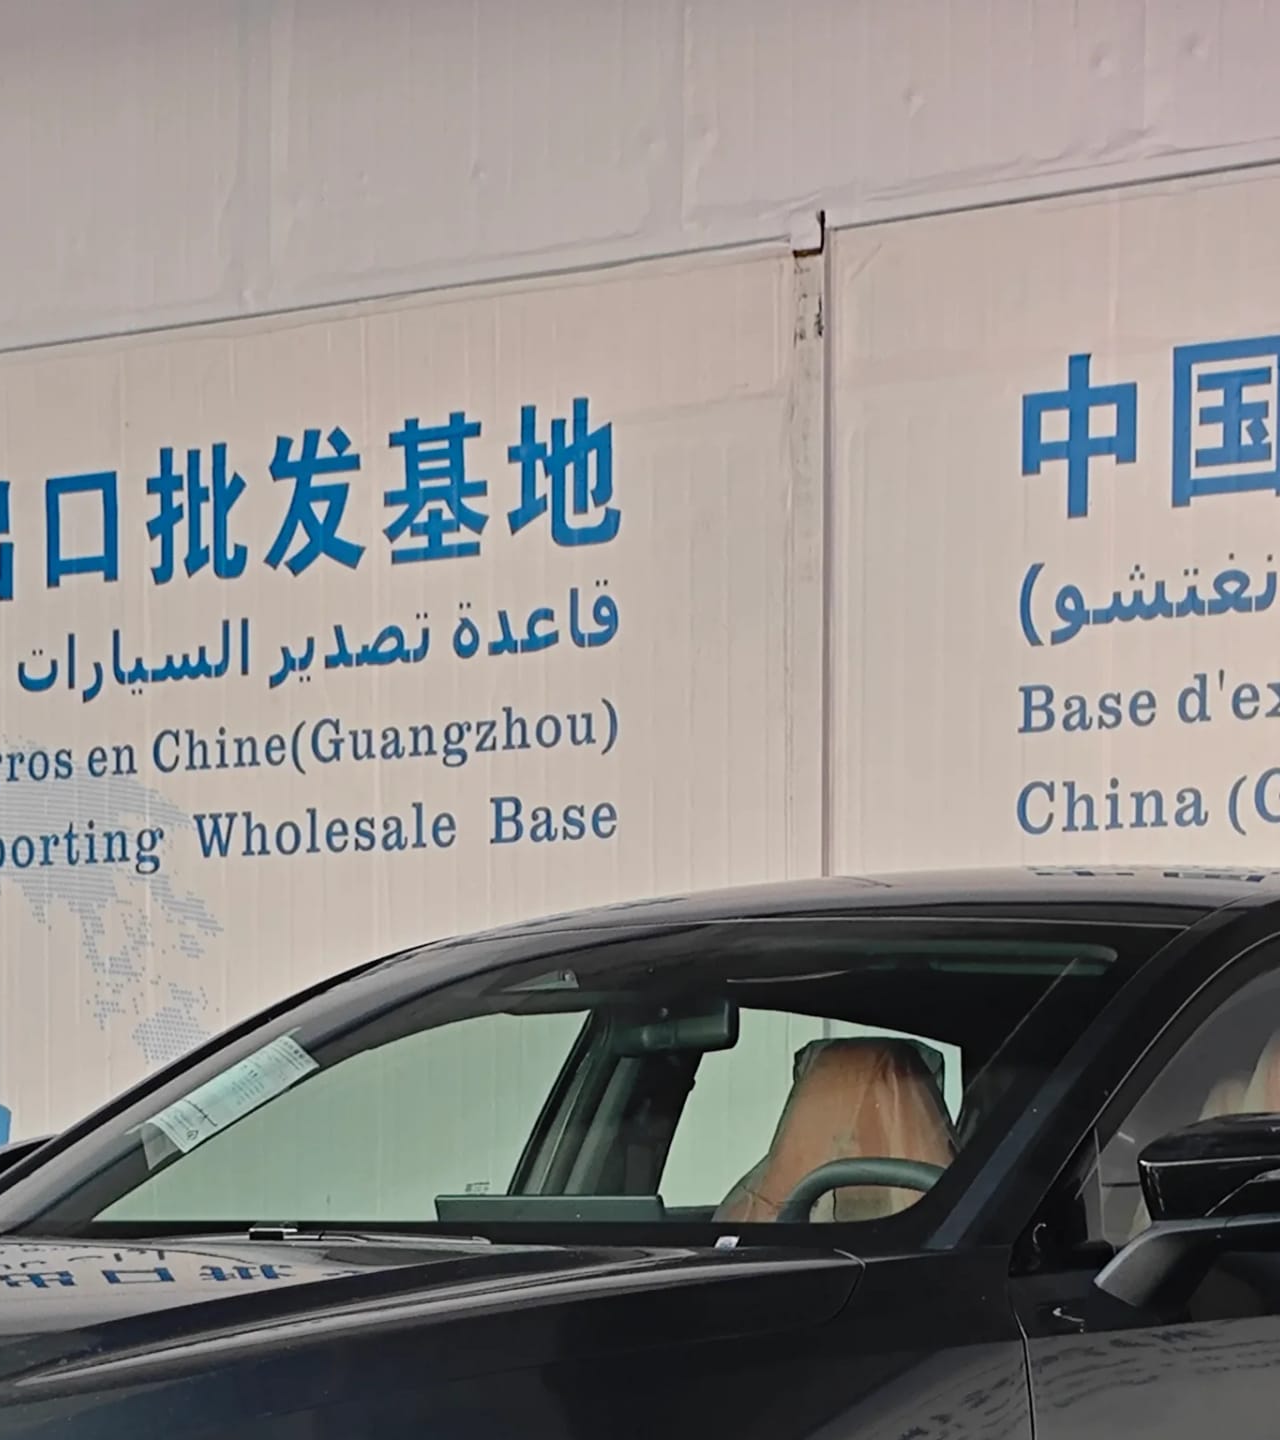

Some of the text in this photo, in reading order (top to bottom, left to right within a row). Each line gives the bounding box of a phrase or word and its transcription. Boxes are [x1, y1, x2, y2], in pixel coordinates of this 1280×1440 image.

[268, 610, 431, 690] تصدير
[452, 578, 620, 660] قاعدة
[16, 617, 250, 704] السيارات
[86, 744, 139, 779] en
[151, 697, 619, 776] Chine(Guangzhou)
[1016, 683, 1158, 735] Base
[191, 801, 457, 860] Wholesale
[488, 795, 618, 845] Base
[1015, 776, 1210, 836] China
